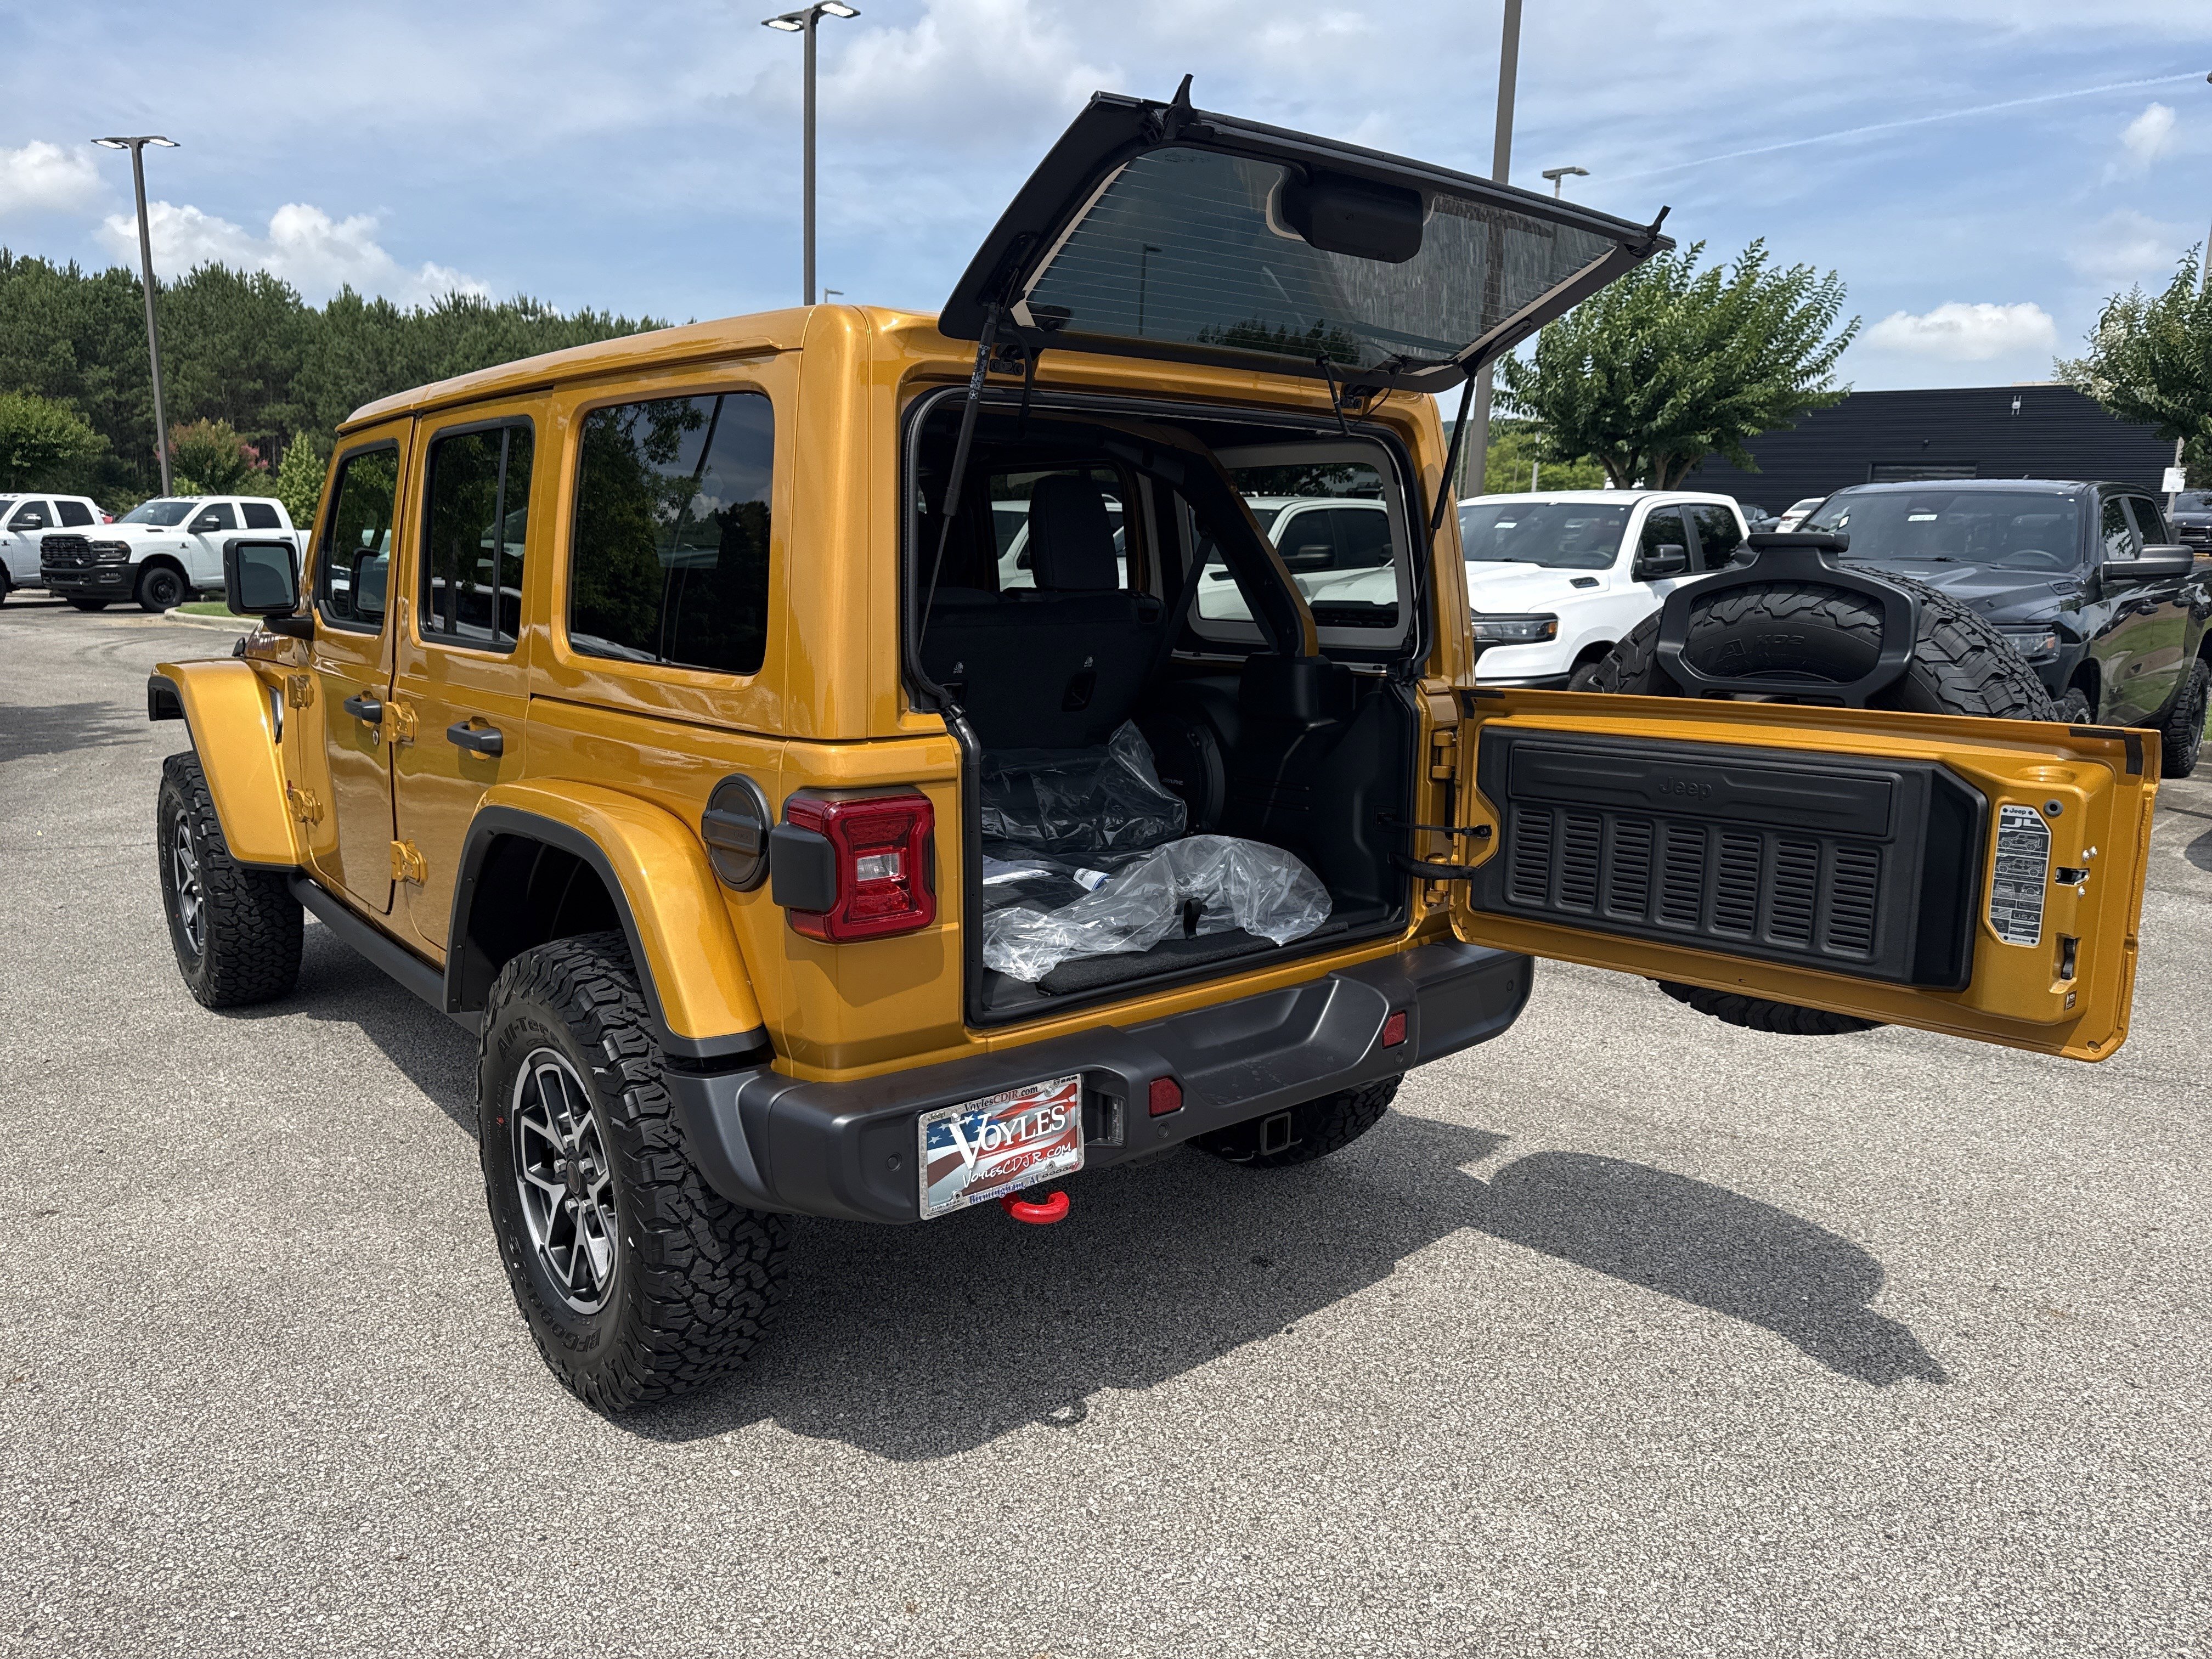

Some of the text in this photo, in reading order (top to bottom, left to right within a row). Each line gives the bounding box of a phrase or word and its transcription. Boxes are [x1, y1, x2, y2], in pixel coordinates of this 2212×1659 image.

[1658, 776, 1712, 801] Jeep
[964, 1085, 1038, 1112] VoylesCDJR.com
[928, 1111, 946, 1121] Jeep
